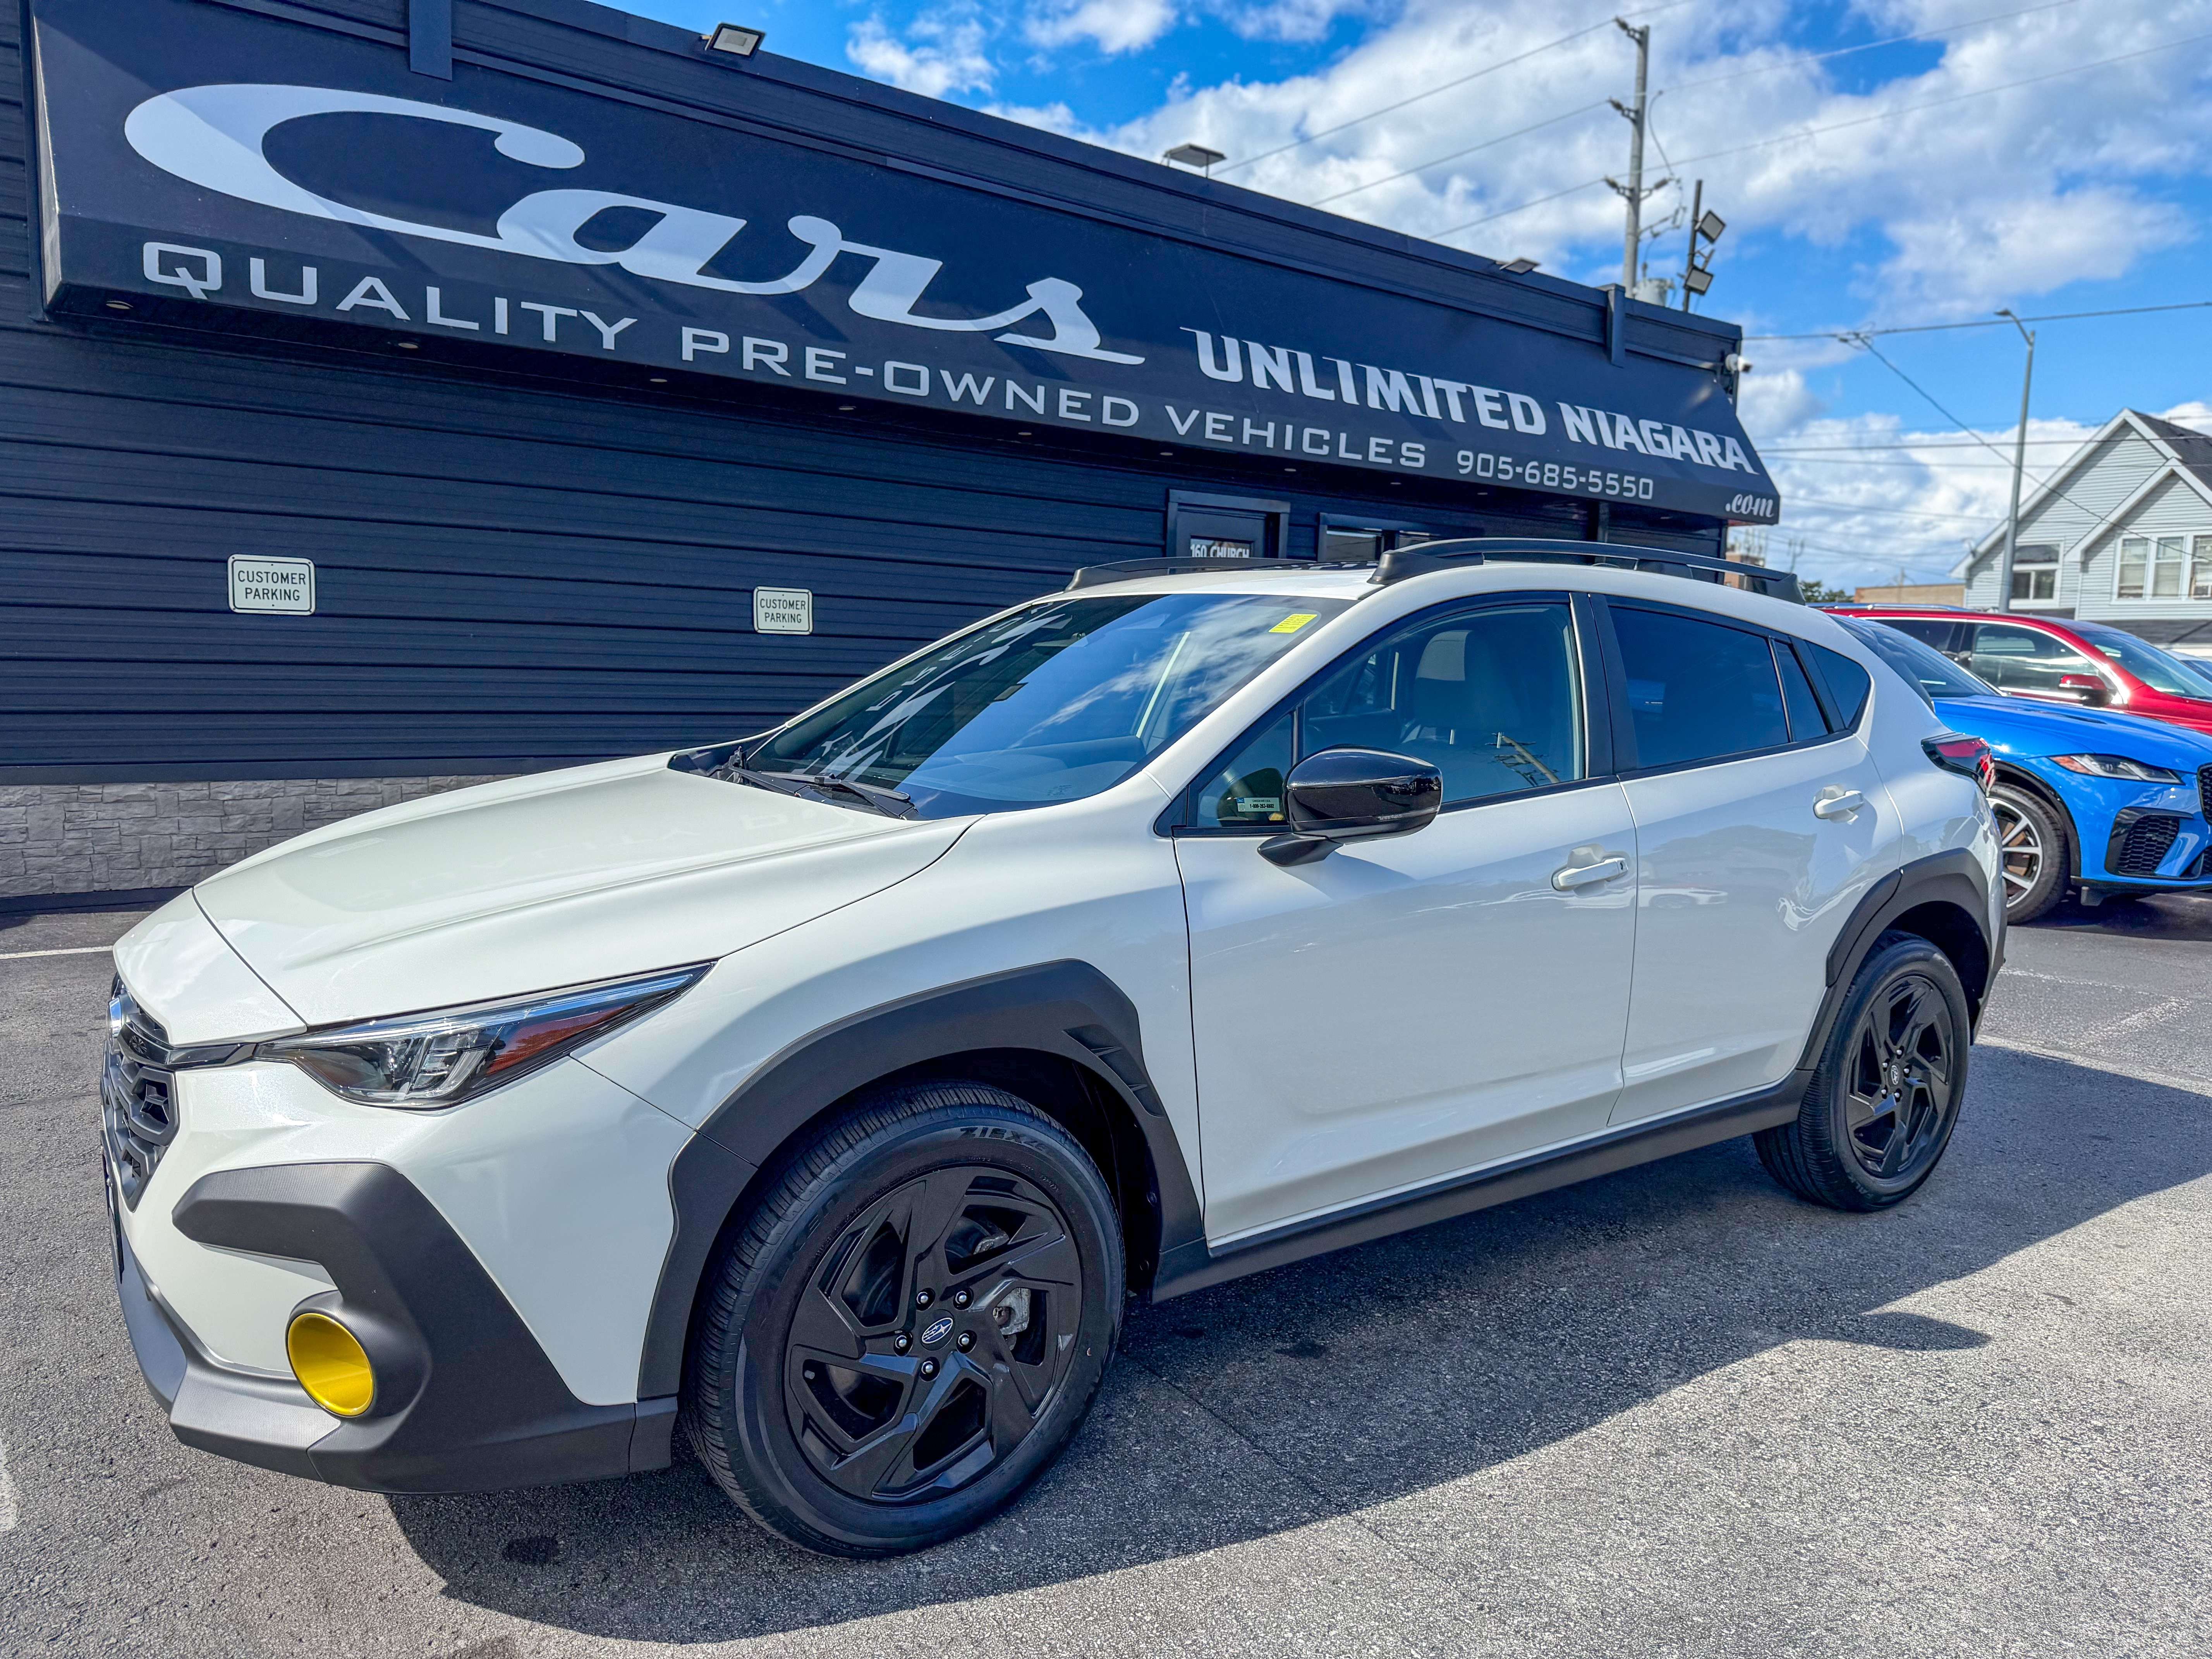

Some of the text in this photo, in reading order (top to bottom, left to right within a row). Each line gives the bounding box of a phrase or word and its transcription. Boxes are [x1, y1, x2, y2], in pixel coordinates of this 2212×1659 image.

[124, 83, 1146, 365] Cars
[143, 241, 1426, 468] QUALITY PRE-OWNED VEHICLES
[1179, 326, 1760, 475] UNLIMITED NIAGARA
[1456, 450, 1654, 500] 905-685-5550
[1725, 493, 1774, 518] .com
[1190, 544, 1250, 558] 160 CHURCH
[238, 570, 306, 585] CUSTOMER
[245, 587, 300, 601] PARKING
[760, 598, 806, 610] CUSTOMER
[764, 612, 802, 623] PARKING
